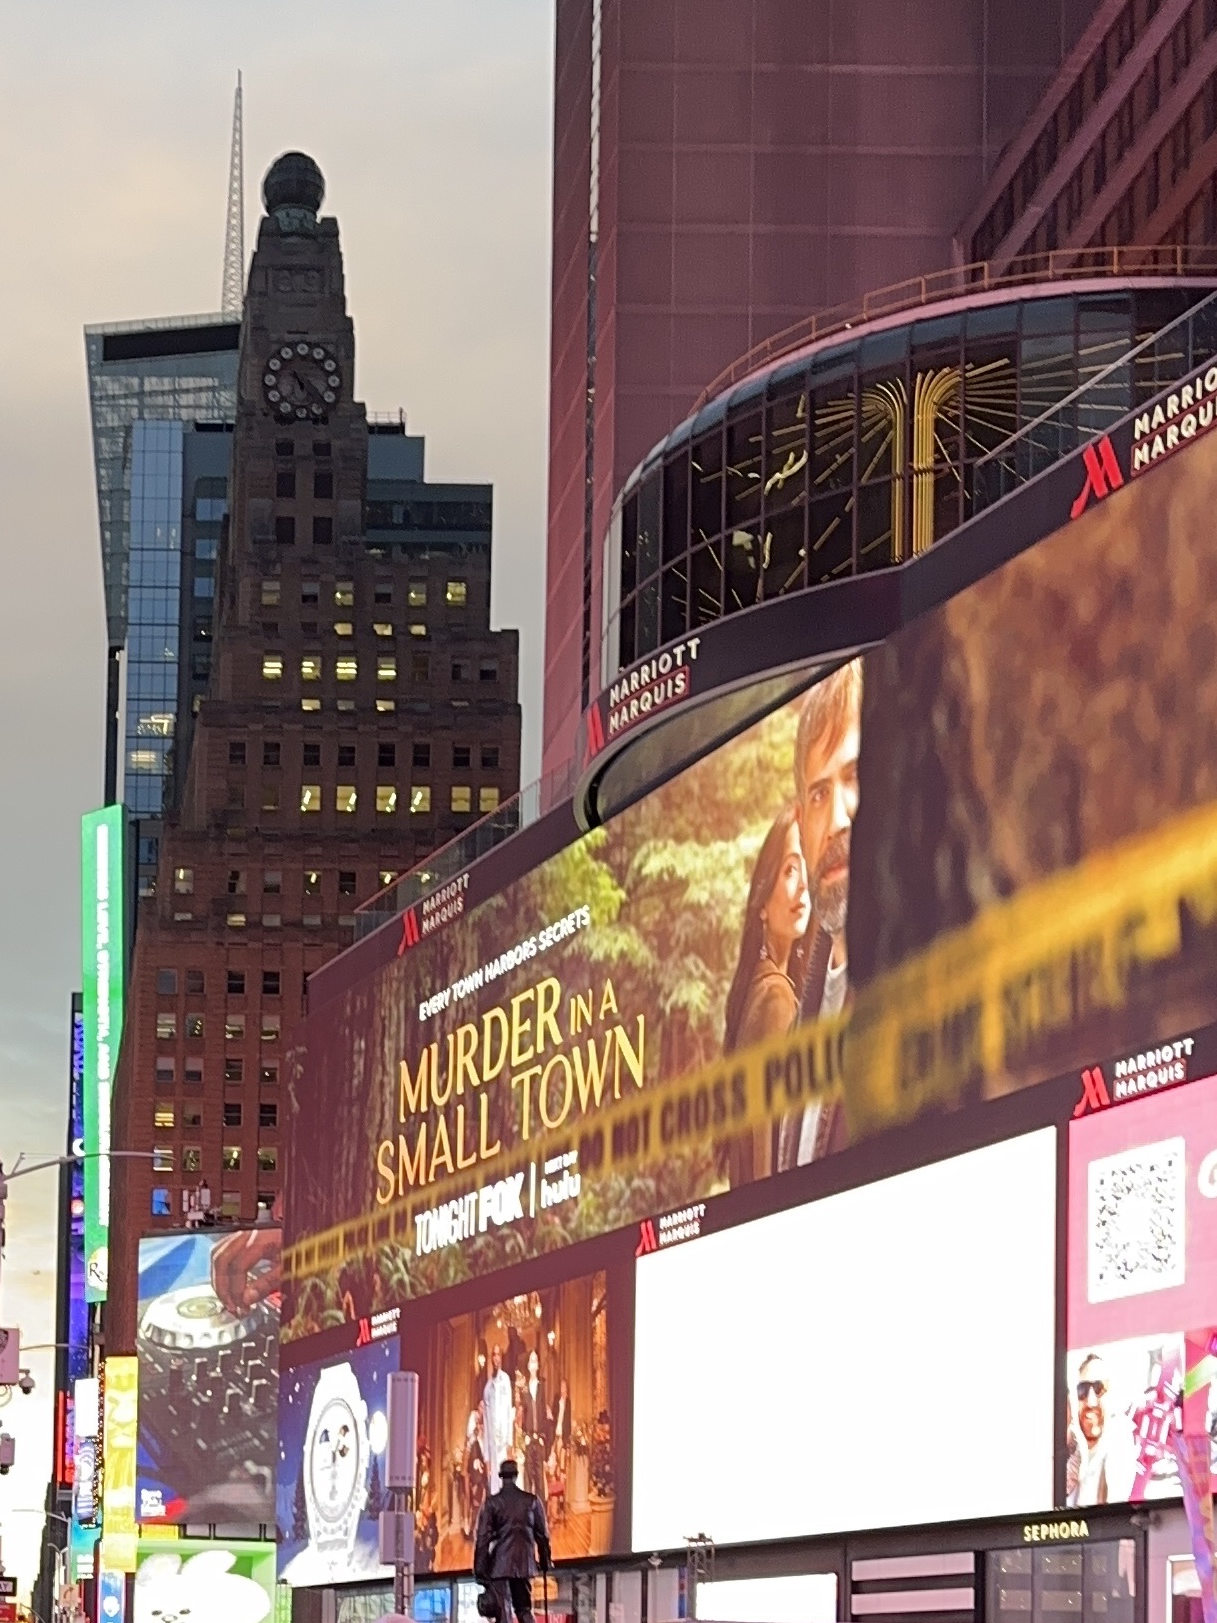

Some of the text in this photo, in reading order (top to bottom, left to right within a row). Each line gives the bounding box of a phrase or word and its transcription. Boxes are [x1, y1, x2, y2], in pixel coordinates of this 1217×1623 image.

[1134, 401, 1217, 471] MARQU
[610, 637, 700, 708] MARRIOTT
[609, 673, 686, 734] MARQUIS
[421, 897, 464, 934] MARQUIS
[422, 873, 470, 915] MARRIOTT
[419, 904, 590, 1021] EVERY TOWN HARBORS SECRETS
[399, 977, 618, 1123] MURDER IN A
[1114, 1062, 1185, 1098] MARQUIS
[1115, 1037, 1194, 1078] MARRIOTT
[376, 1014, 645, 1204] SMALL TOWN
[415, 1192, 478, 1256] TONIGHT
[479, 1172, 524, 1232] FOX
[541, 1170, 581, 1208] hulu
[1023, 1520, 1089, 1542] SEPHORA
